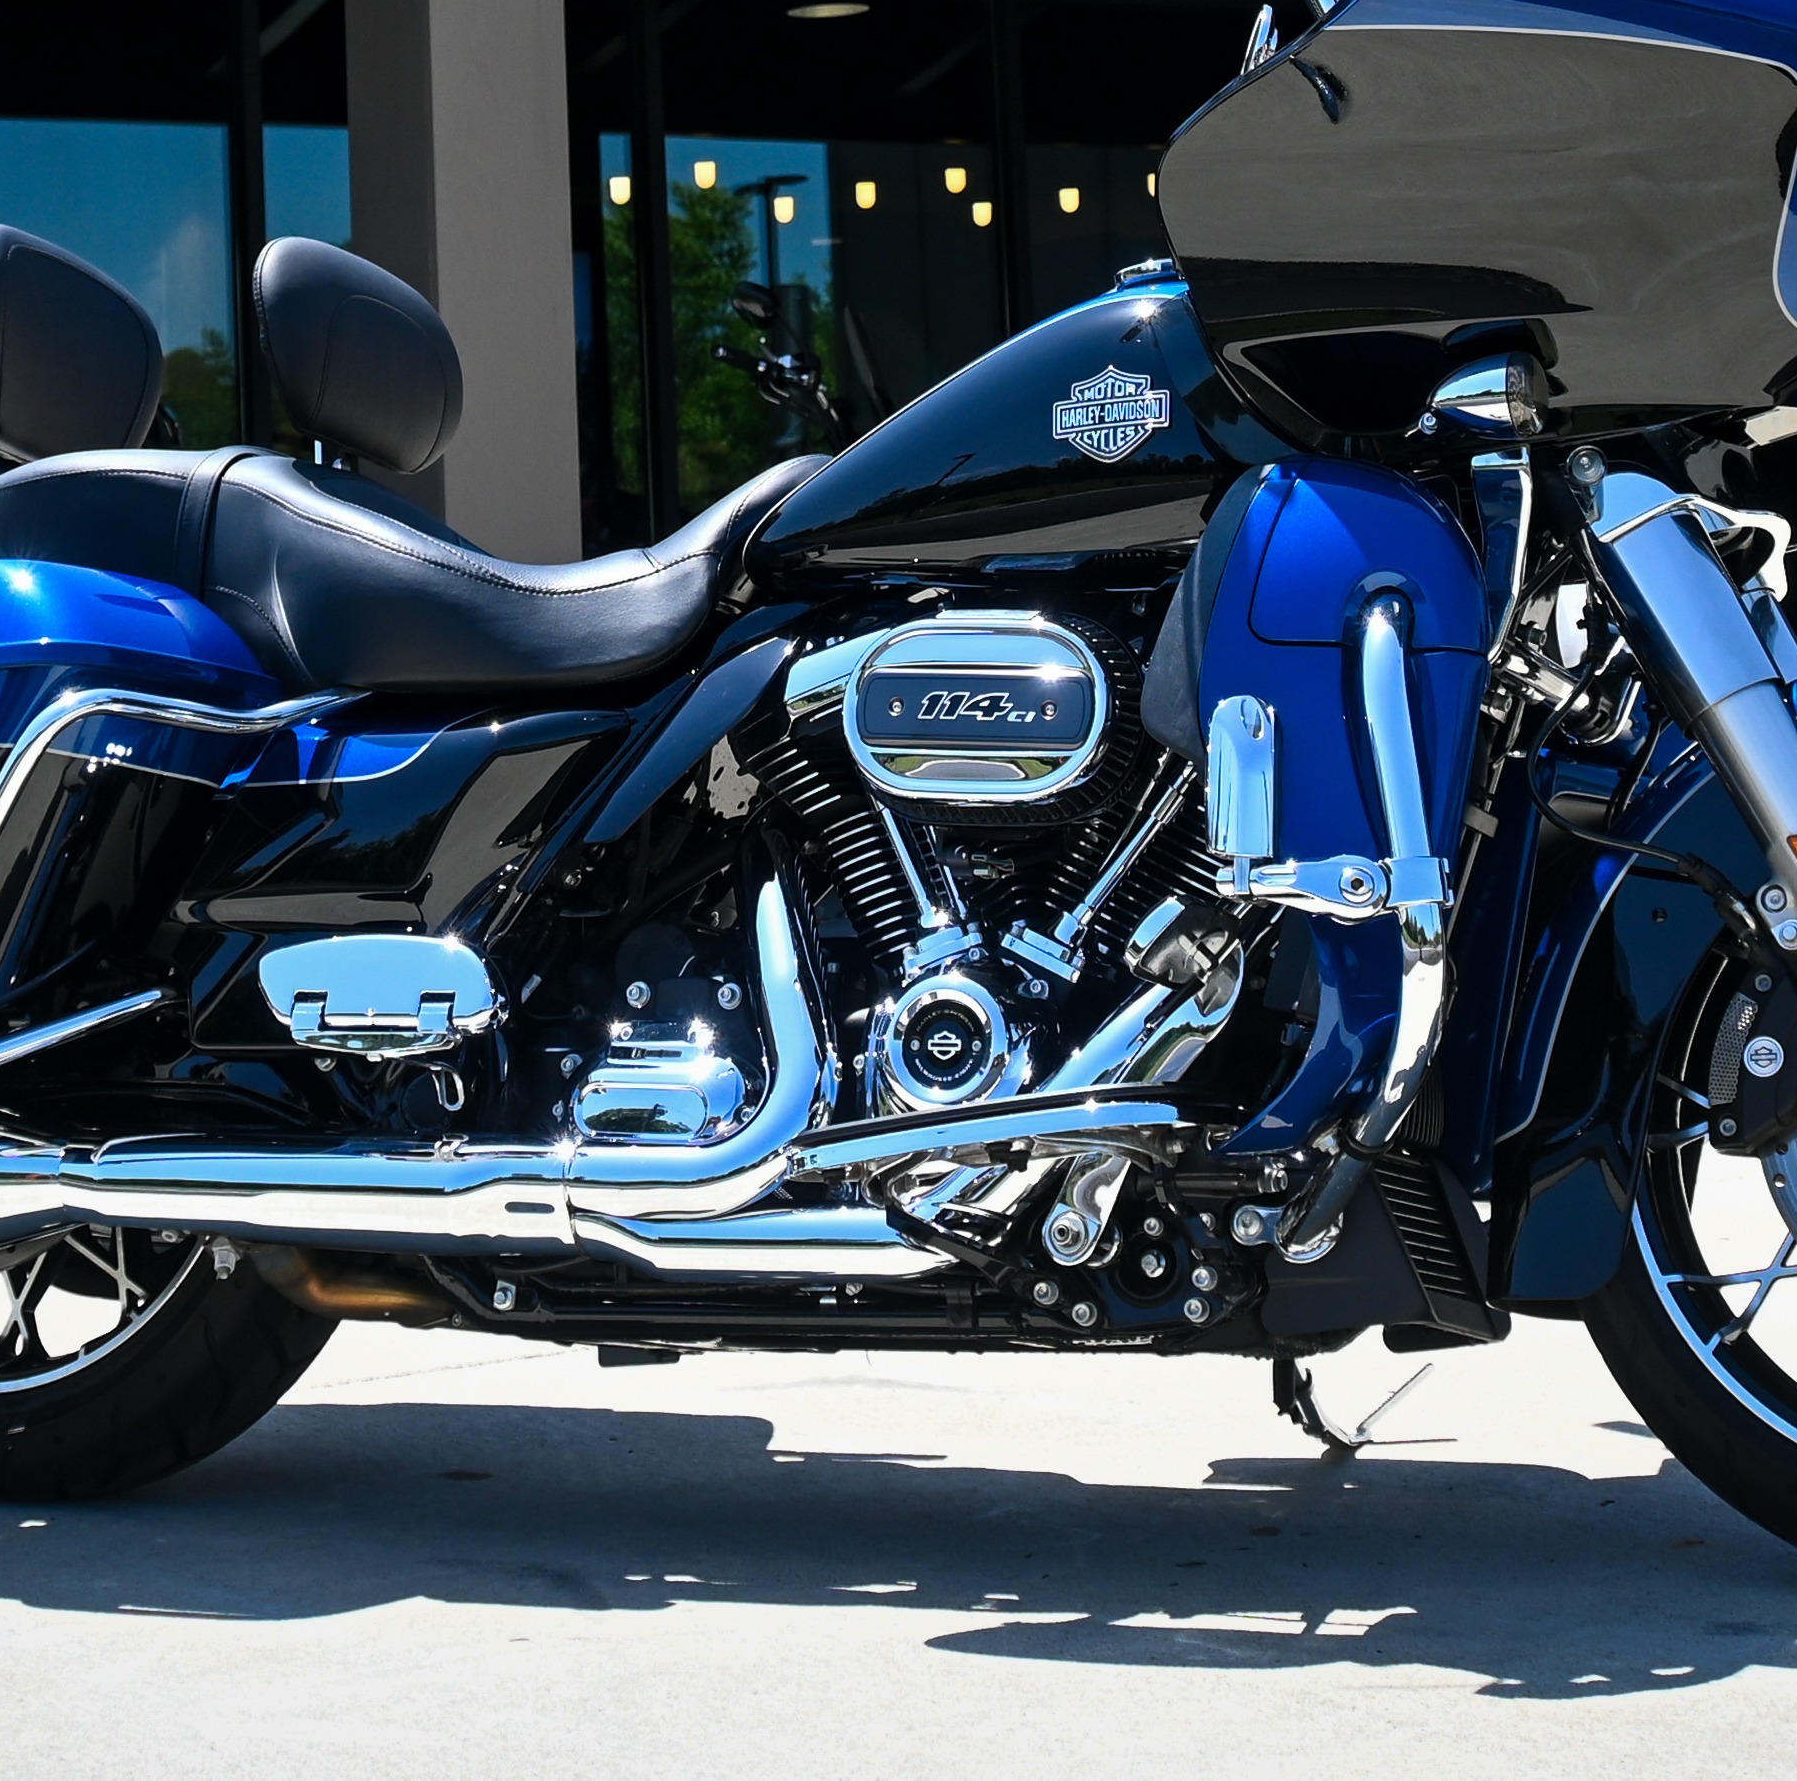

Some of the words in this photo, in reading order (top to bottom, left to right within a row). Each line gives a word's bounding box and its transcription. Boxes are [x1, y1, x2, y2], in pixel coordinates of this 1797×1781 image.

[1084, 378, 1136, 400] MOTOR
[1061, 399, 1160, 429] HARLEY-DAVIDSON
[1083, 426, 1136, 452] CYCLES
[917, 691, 1014, 721] 114
